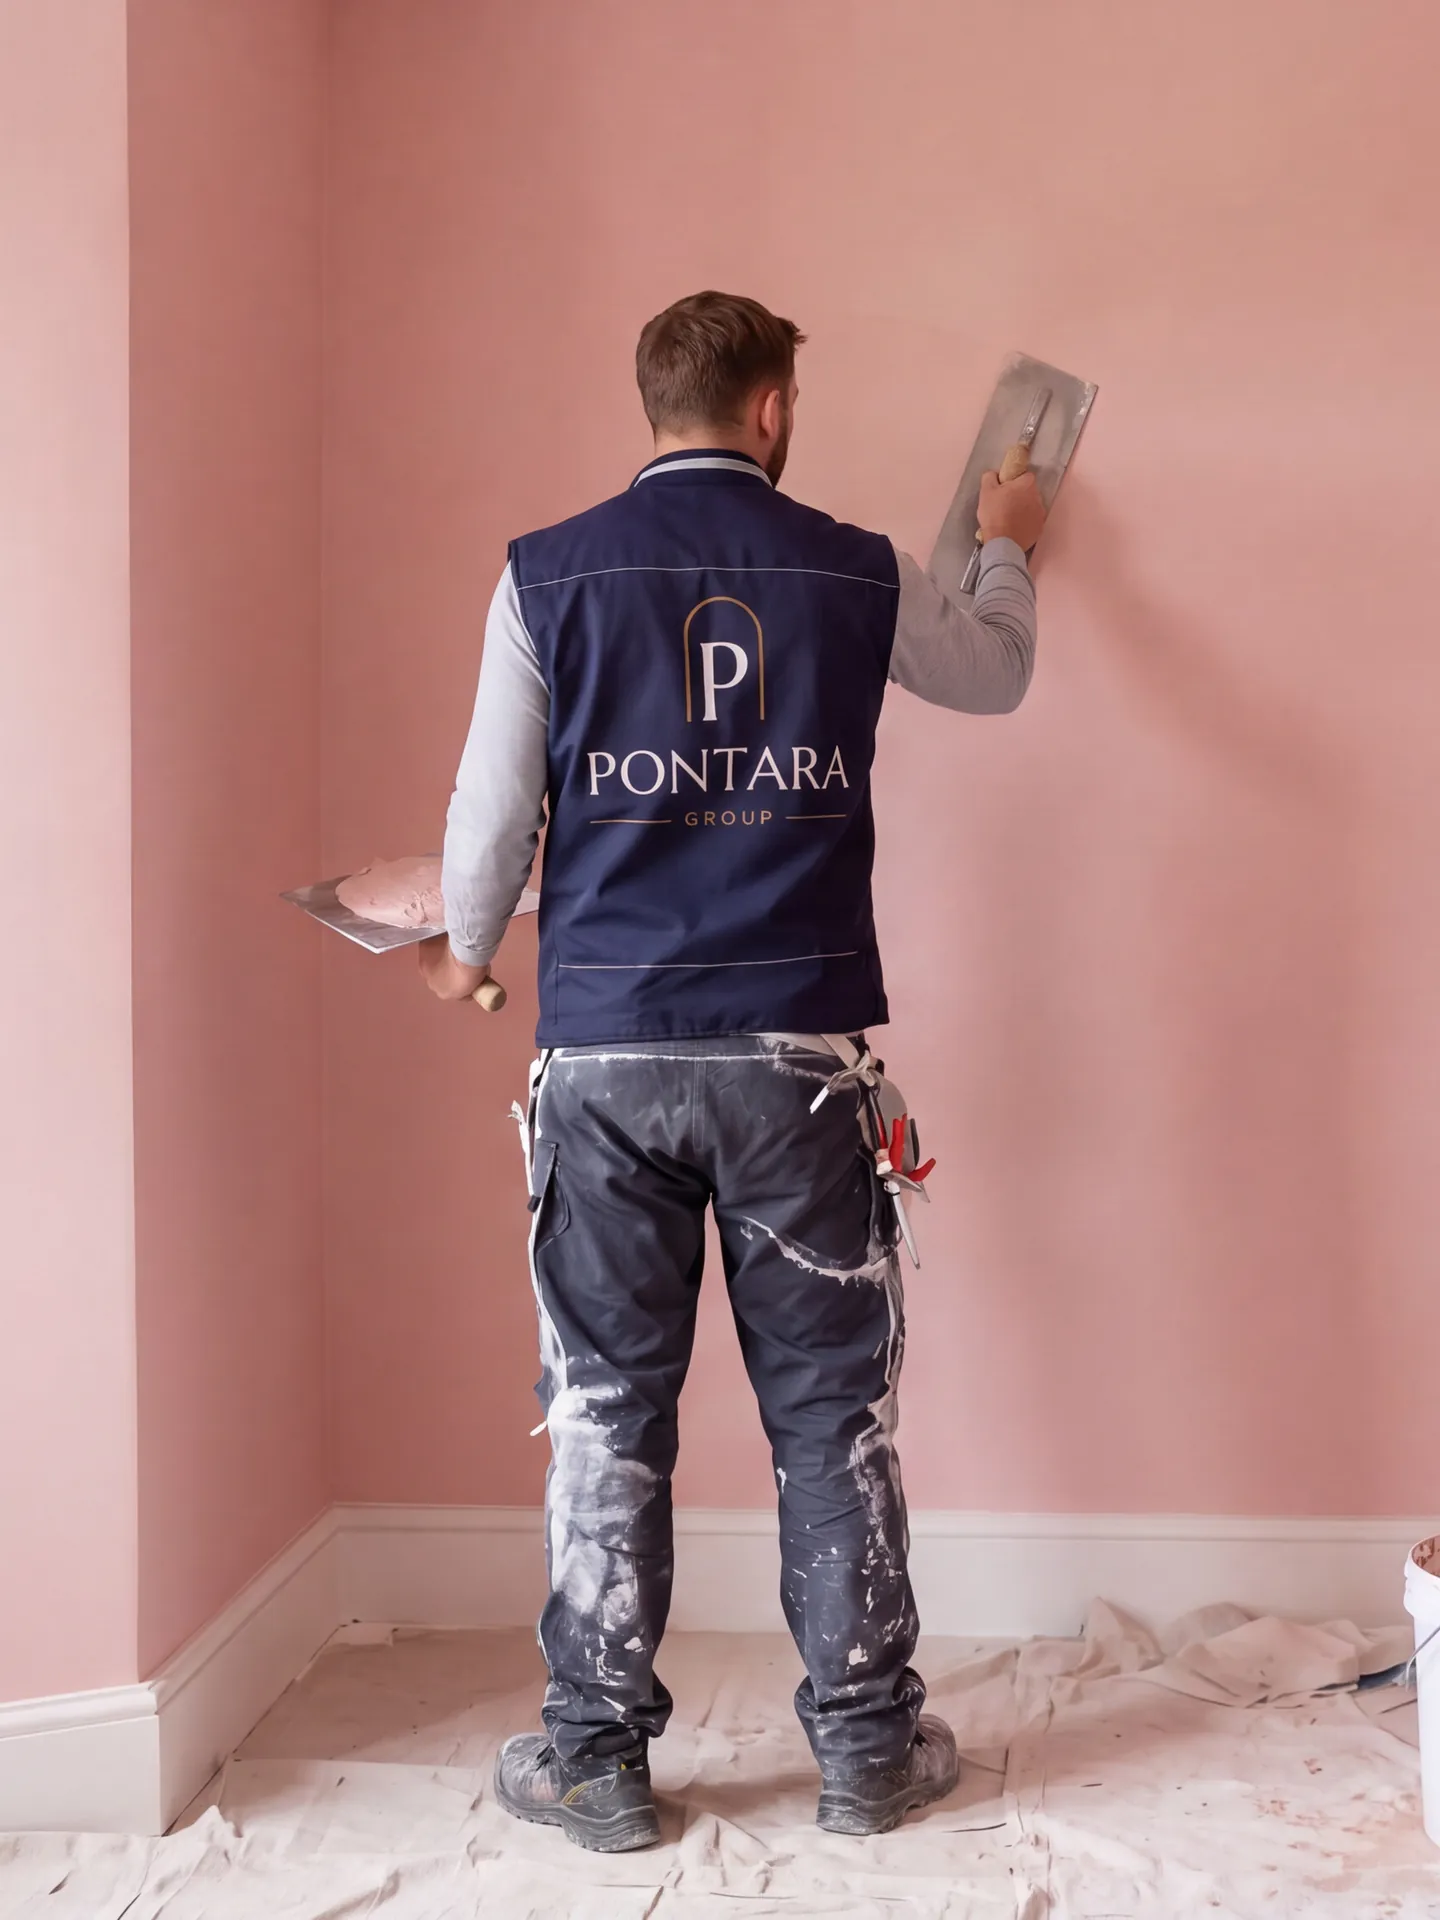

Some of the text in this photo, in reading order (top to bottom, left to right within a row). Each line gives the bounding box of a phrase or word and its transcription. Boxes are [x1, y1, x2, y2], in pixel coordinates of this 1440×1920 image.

[700, 641, 749, 722] P
[587, 745, 849, 796] PONTARA
[685, 810, 773, 826] GROUP
